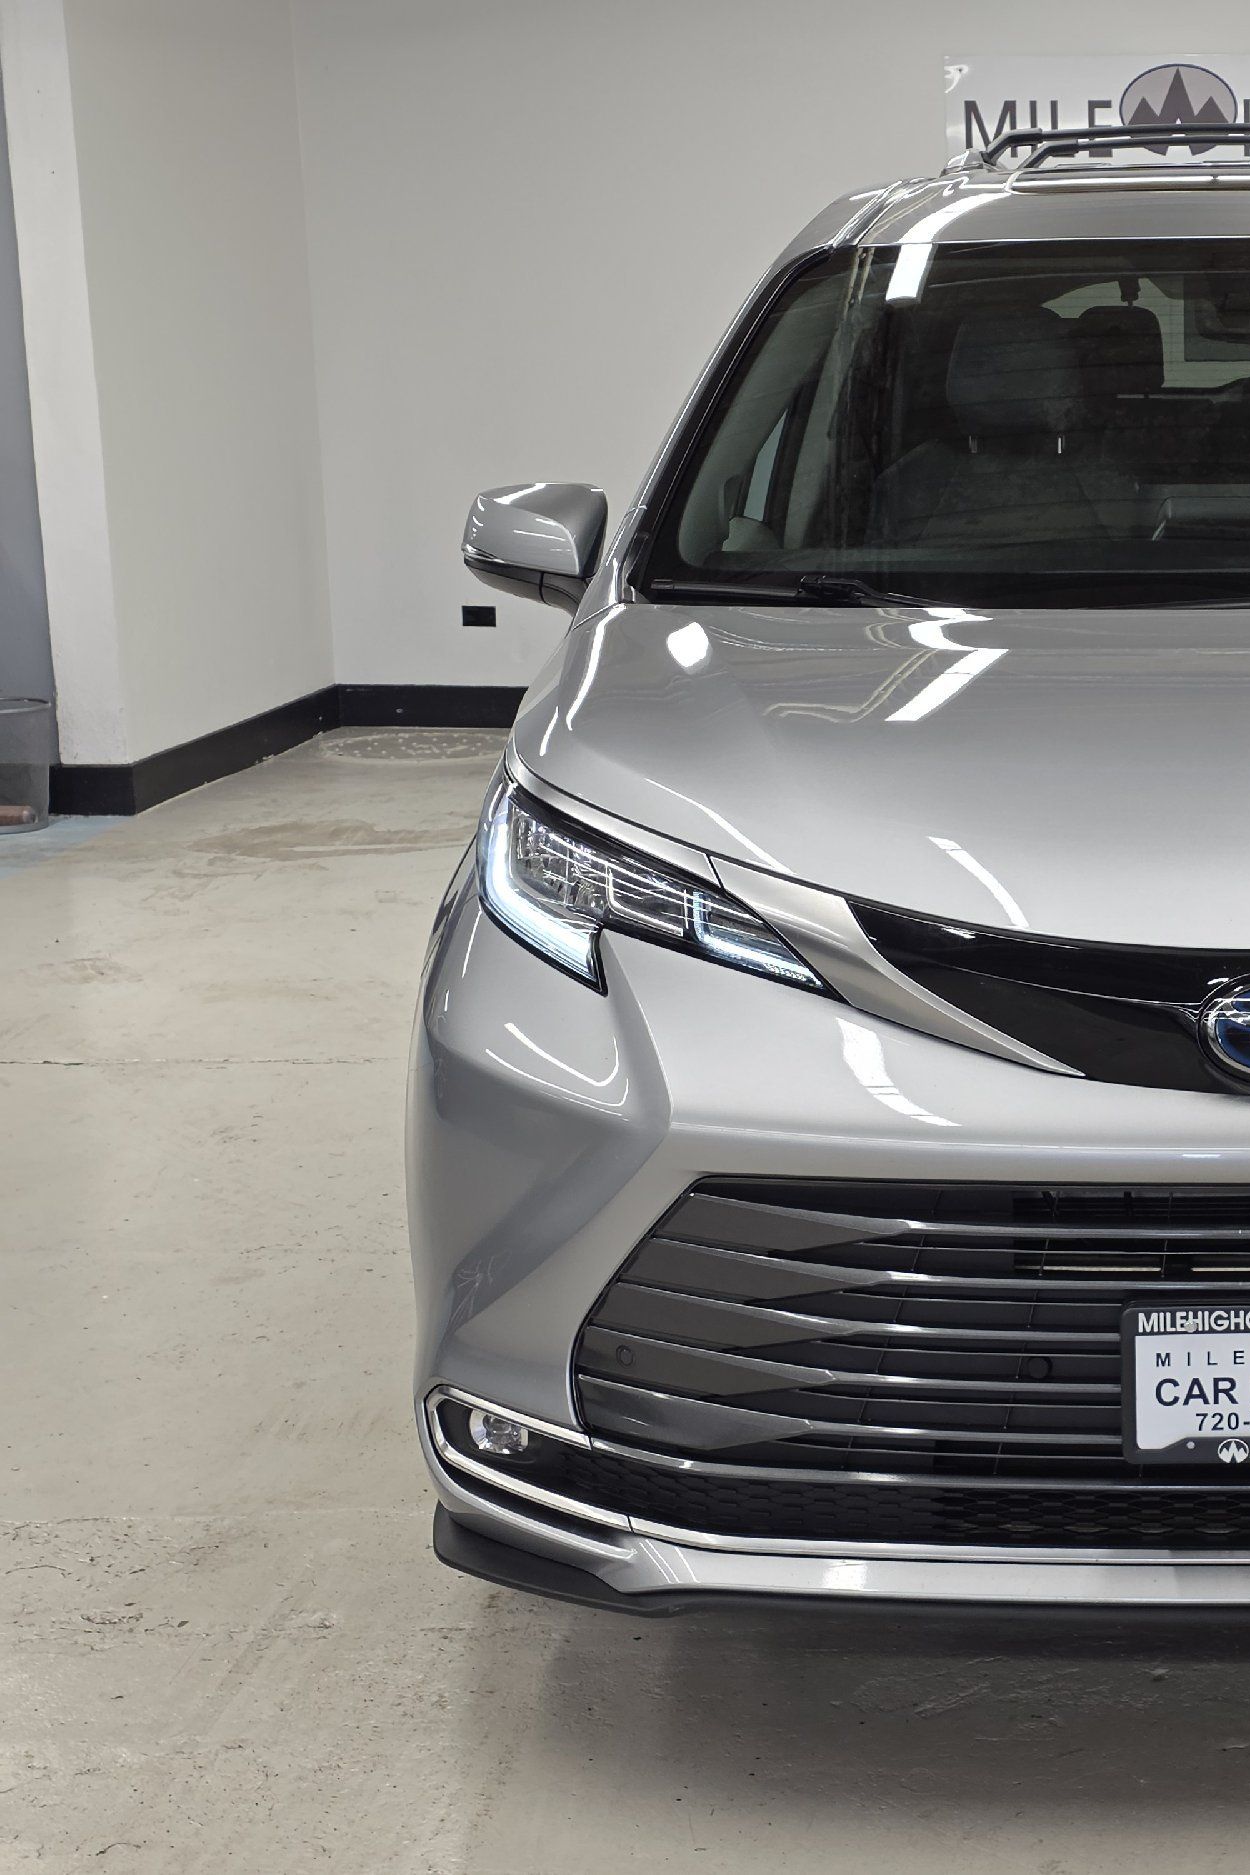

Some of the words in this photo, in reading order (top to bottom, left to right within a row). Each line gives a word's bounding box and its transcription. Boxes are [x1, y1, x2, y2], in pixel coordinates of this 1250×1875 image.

[964, 100, 1114, 157] MILE
[1155, 1350, 1245, 1367] MILE
[1155, 1377, 1239, 1407] CAR
